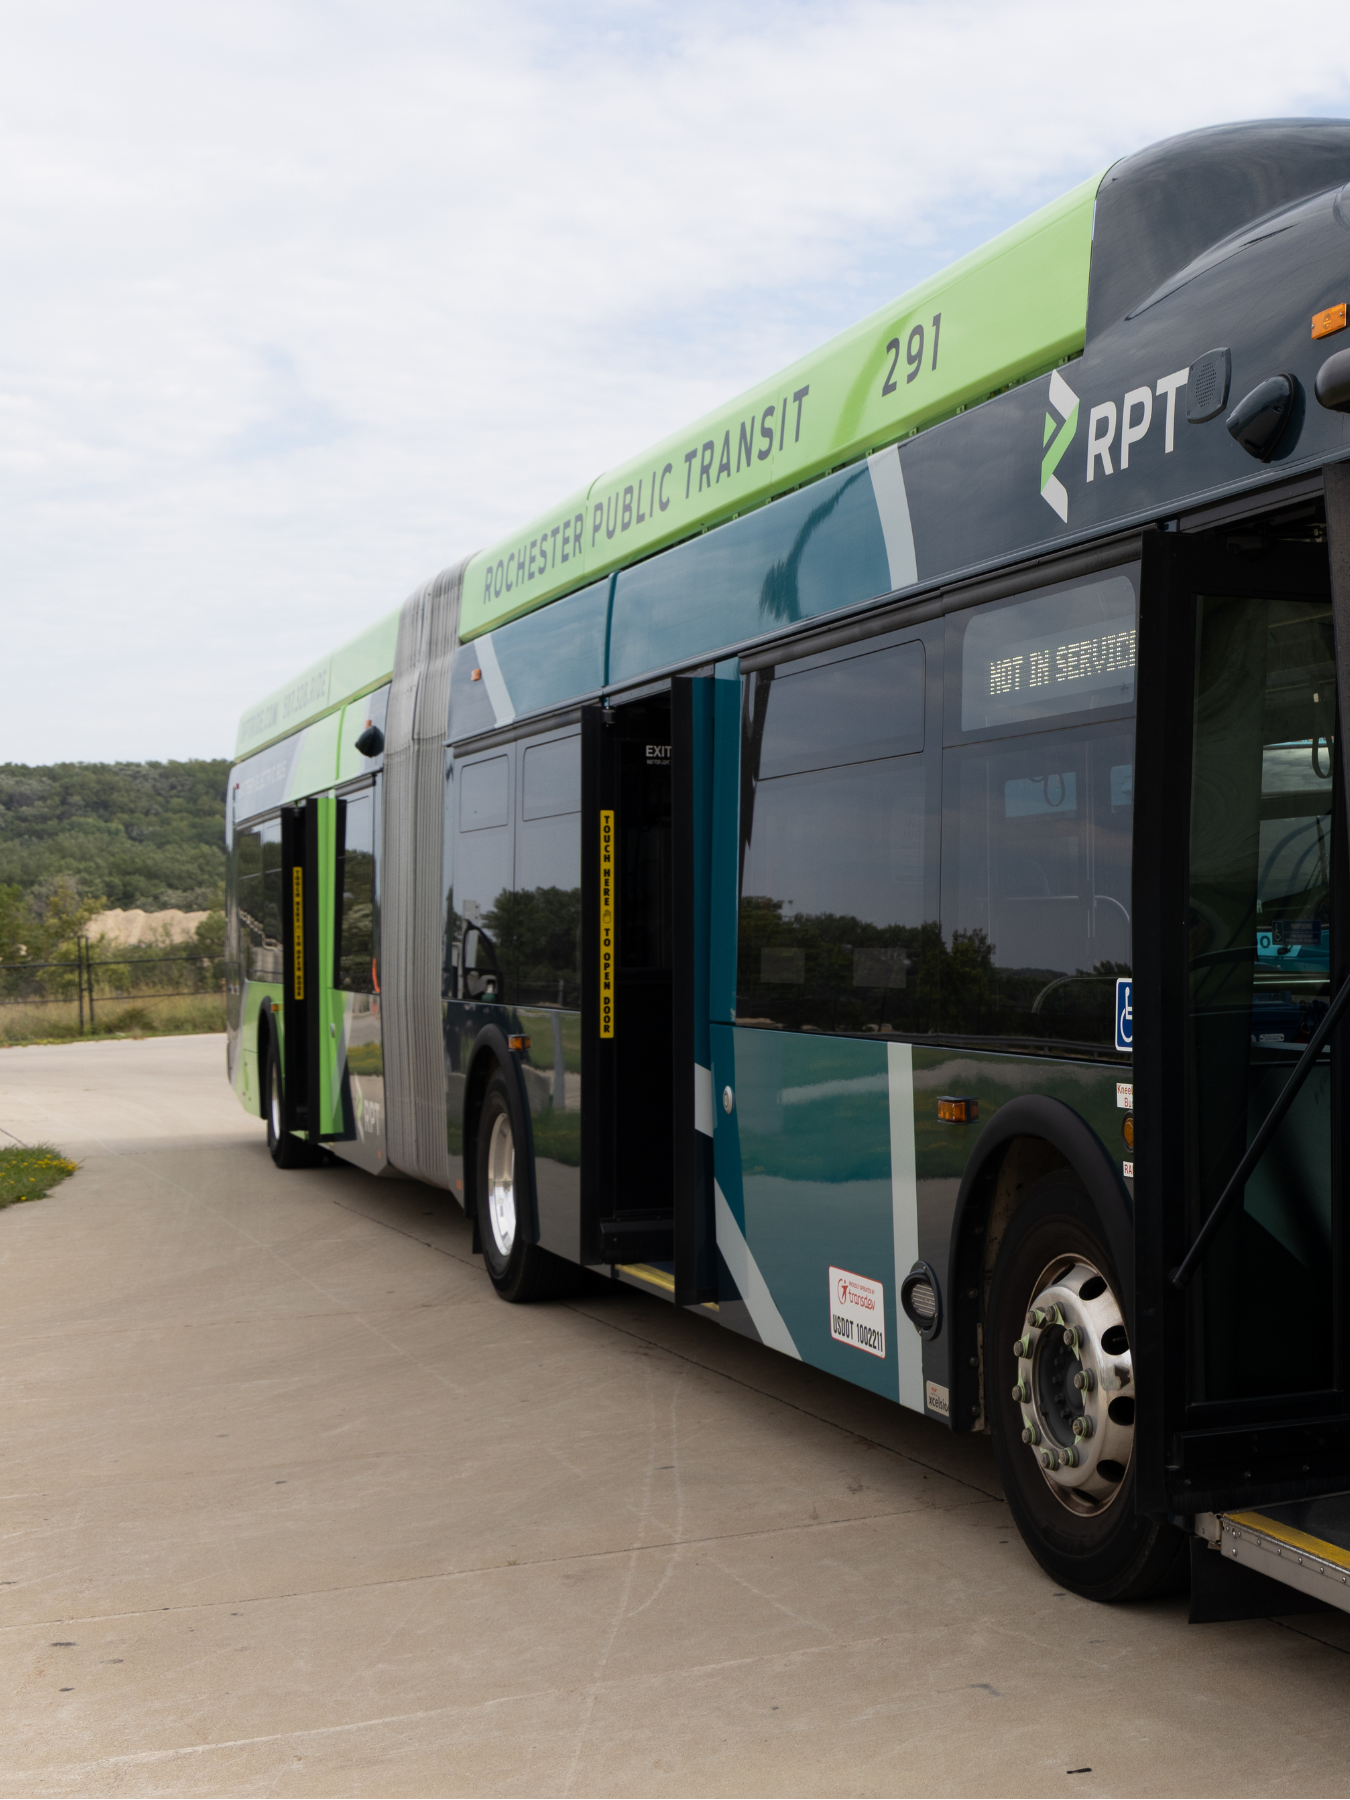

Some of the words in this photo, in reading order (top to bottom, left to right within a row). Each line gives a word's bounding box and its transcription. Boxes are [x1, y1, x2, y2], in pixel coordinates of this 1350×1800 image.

[882, 312, 942, 398] 291
[1086, 366, 1190, 483] RPT
[483, 512, 585, 605] ROCHESTER
[591, 462, 673, 548] PUBLIC
[684, 383, 810, 500] TRANSIT
[990, 656, 1024, 695] NOT
[645, 744, 672, 758] EXIT
[603, 815, 611, 863] TOUCH
[603, 868, 611, 907] HERE
[603, 928, 611, 948] TO
[603, 952, 611, 991] OPEN
[603, 996, 611, 1033] DOOR
[363, 1099, 381, 1136] RPT
[848, 1289, 876, 1311] transdev
[832, 1313, 854, 1340] USDOT
[856, 1322, 883, 1352] 1002211
